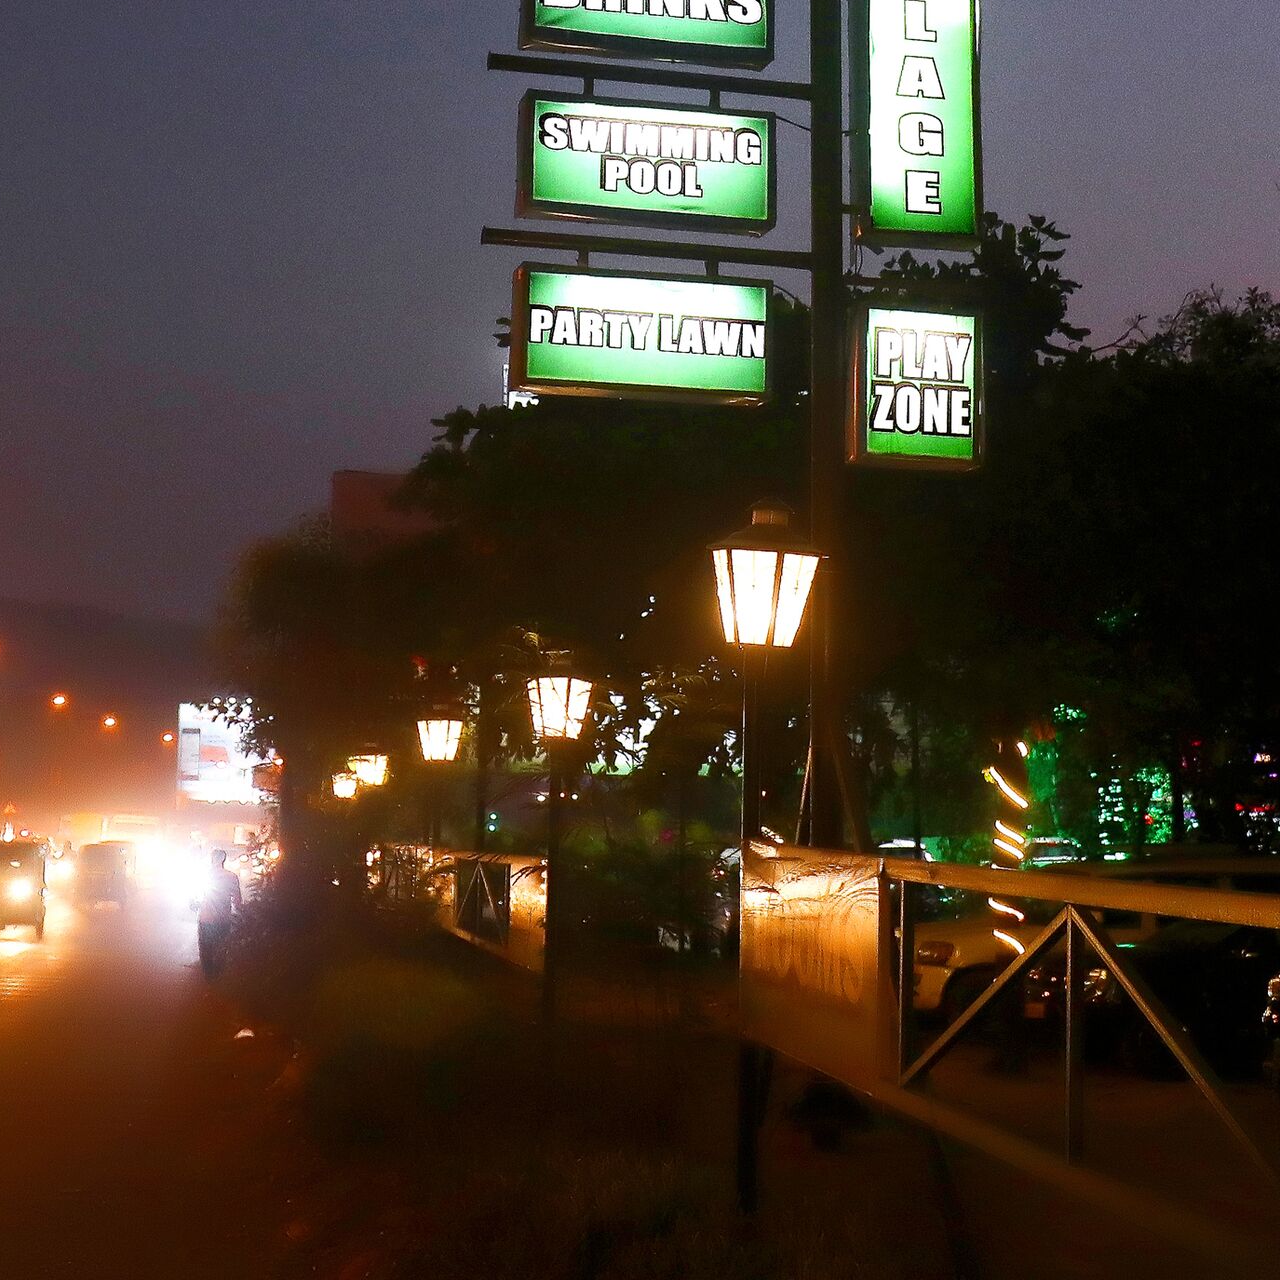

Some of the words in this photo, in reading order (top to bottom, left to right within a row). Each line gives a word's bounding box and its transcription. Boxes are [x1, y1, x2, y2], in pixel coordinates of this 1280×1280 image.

[539, 112, 762, 165] SWIMMING
[600, 155, 703, 197] POOL
[529, 304, 653, 350] PARTY
[659, 313, 765, 358] LAWN
[874, 326, 972, 383] PLAY
[871, 380, 972, 437] ZONE
